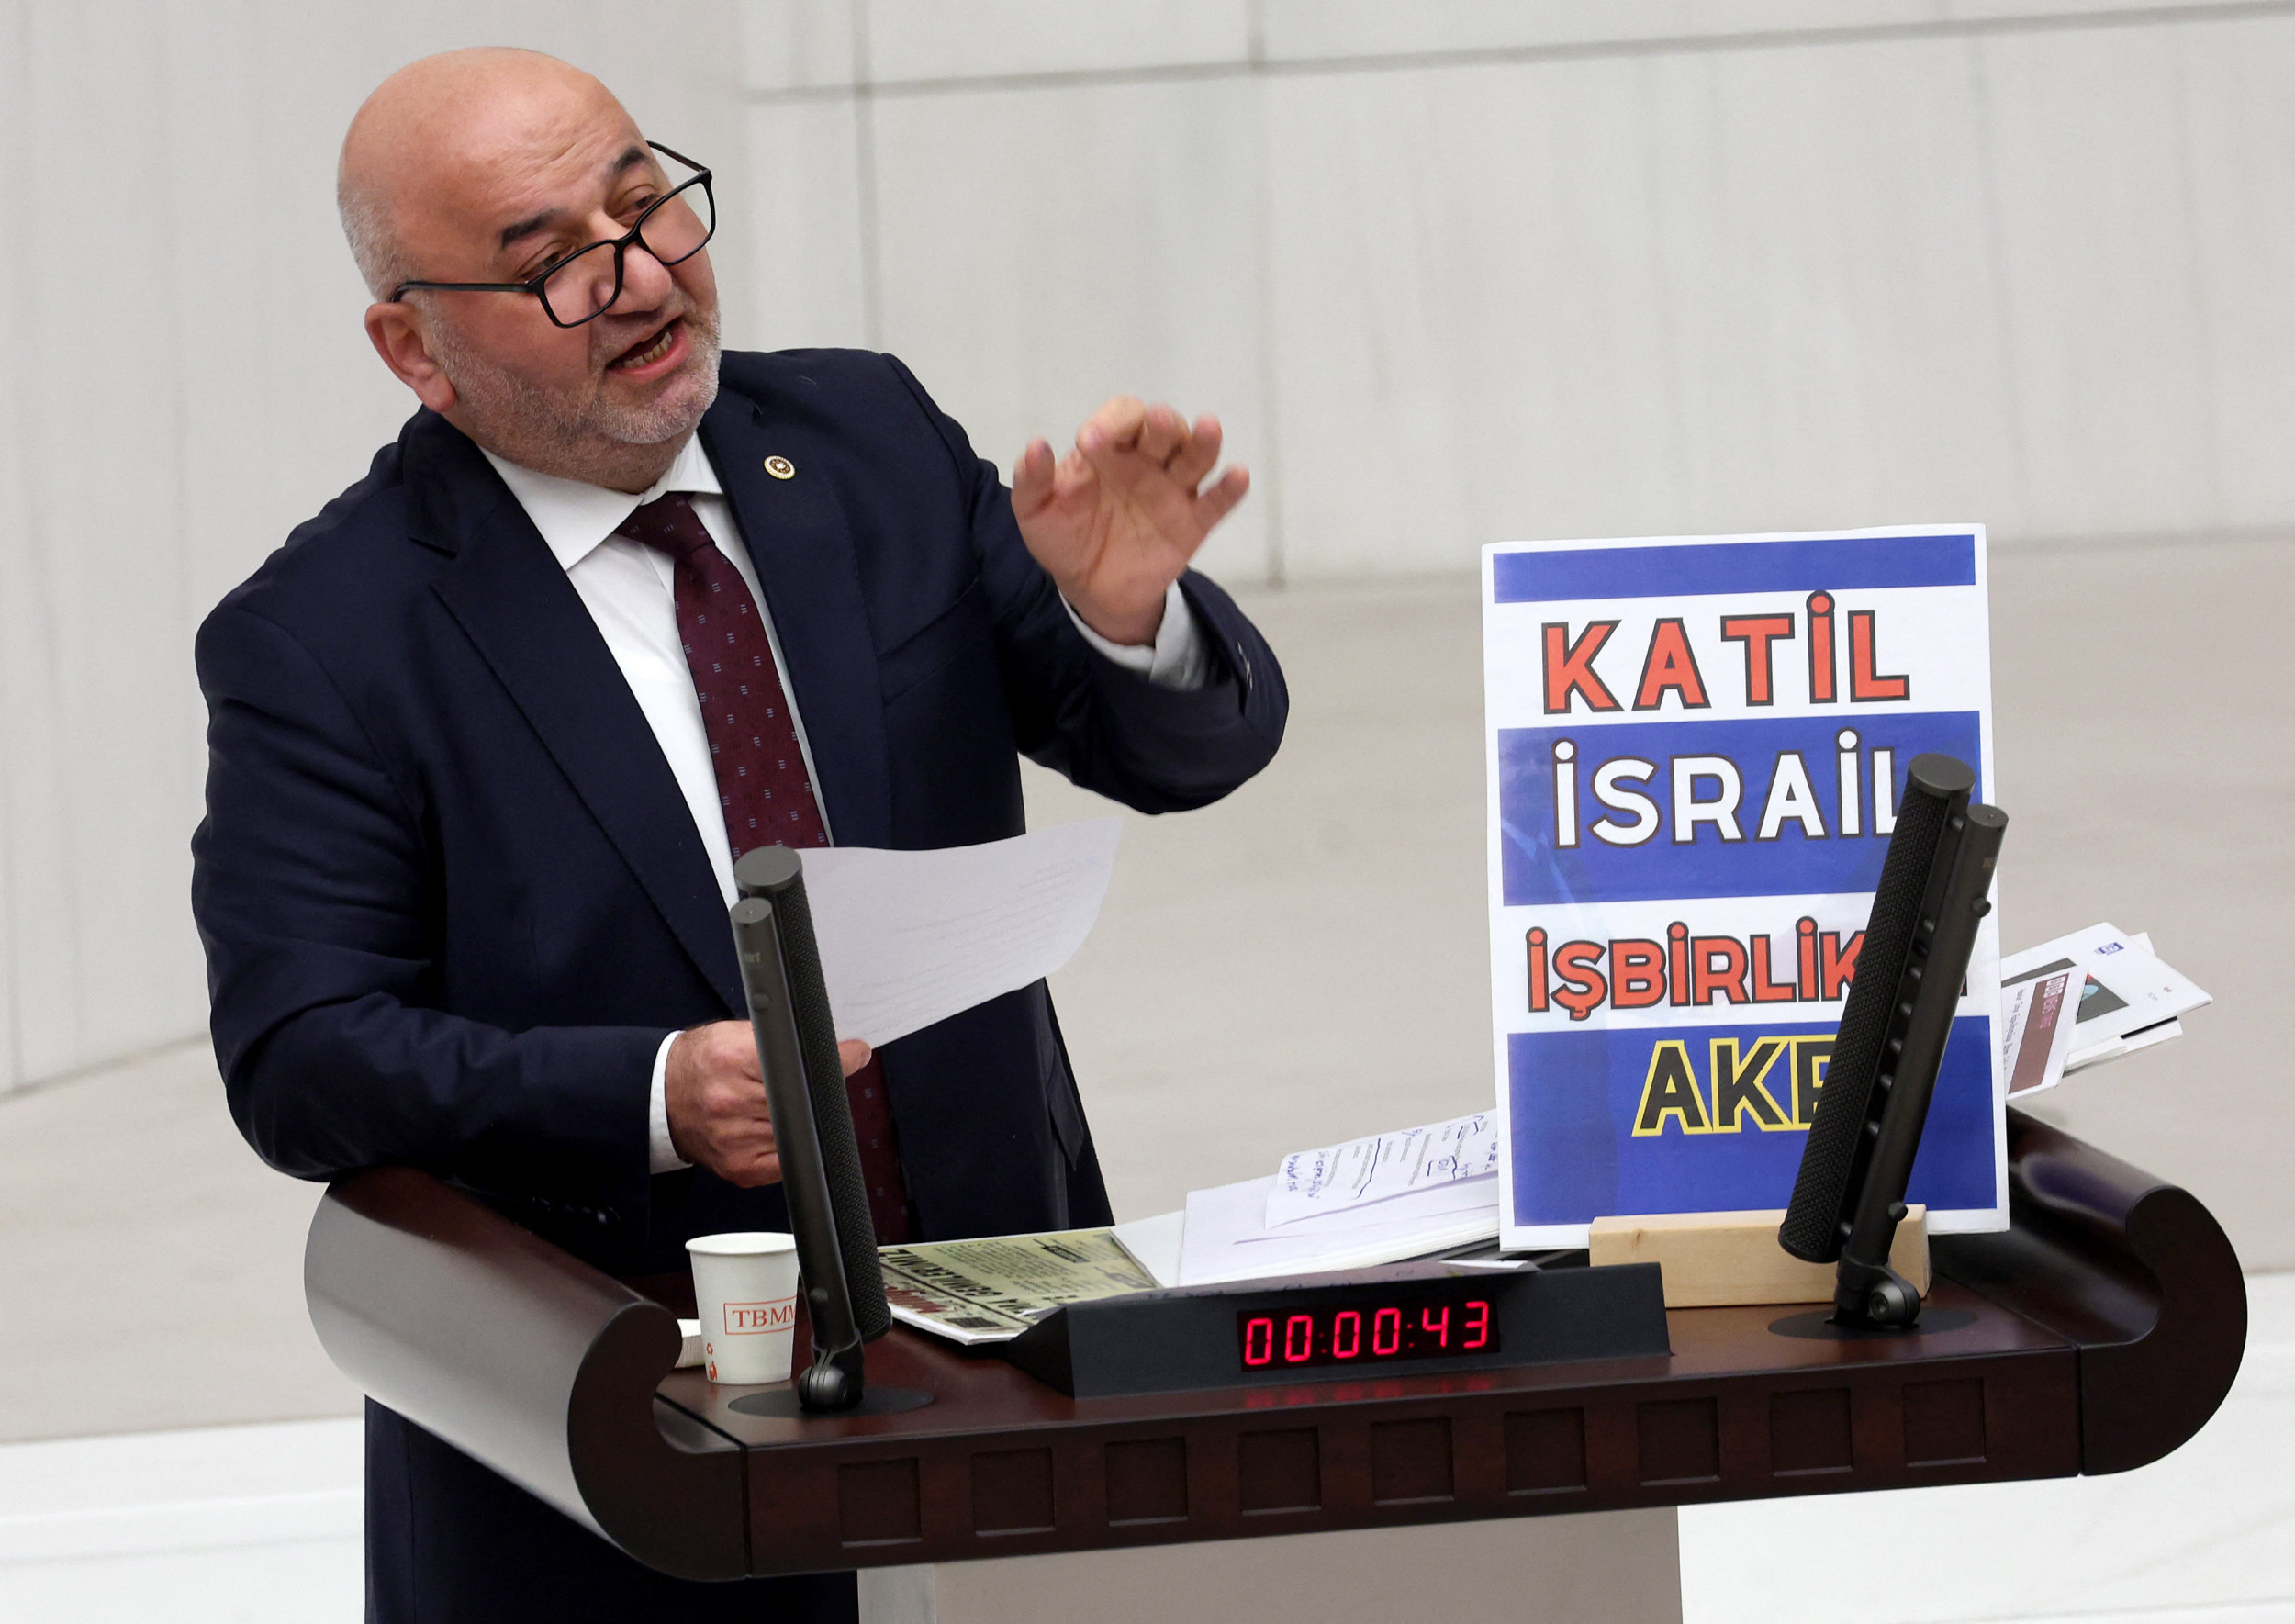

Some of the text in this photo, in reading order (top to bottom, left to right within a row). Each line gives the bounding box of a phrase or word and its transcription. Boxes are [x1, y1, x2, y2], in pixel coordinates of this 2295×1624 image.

[1541, 590, 1910, 714] KATİL
[1551, 726, 1898, 848] İSRAİL
[1526, 915, 1967, 1021] İŞBİRLİK
[1245, 1300, 1489, 1366] 00:00:43
